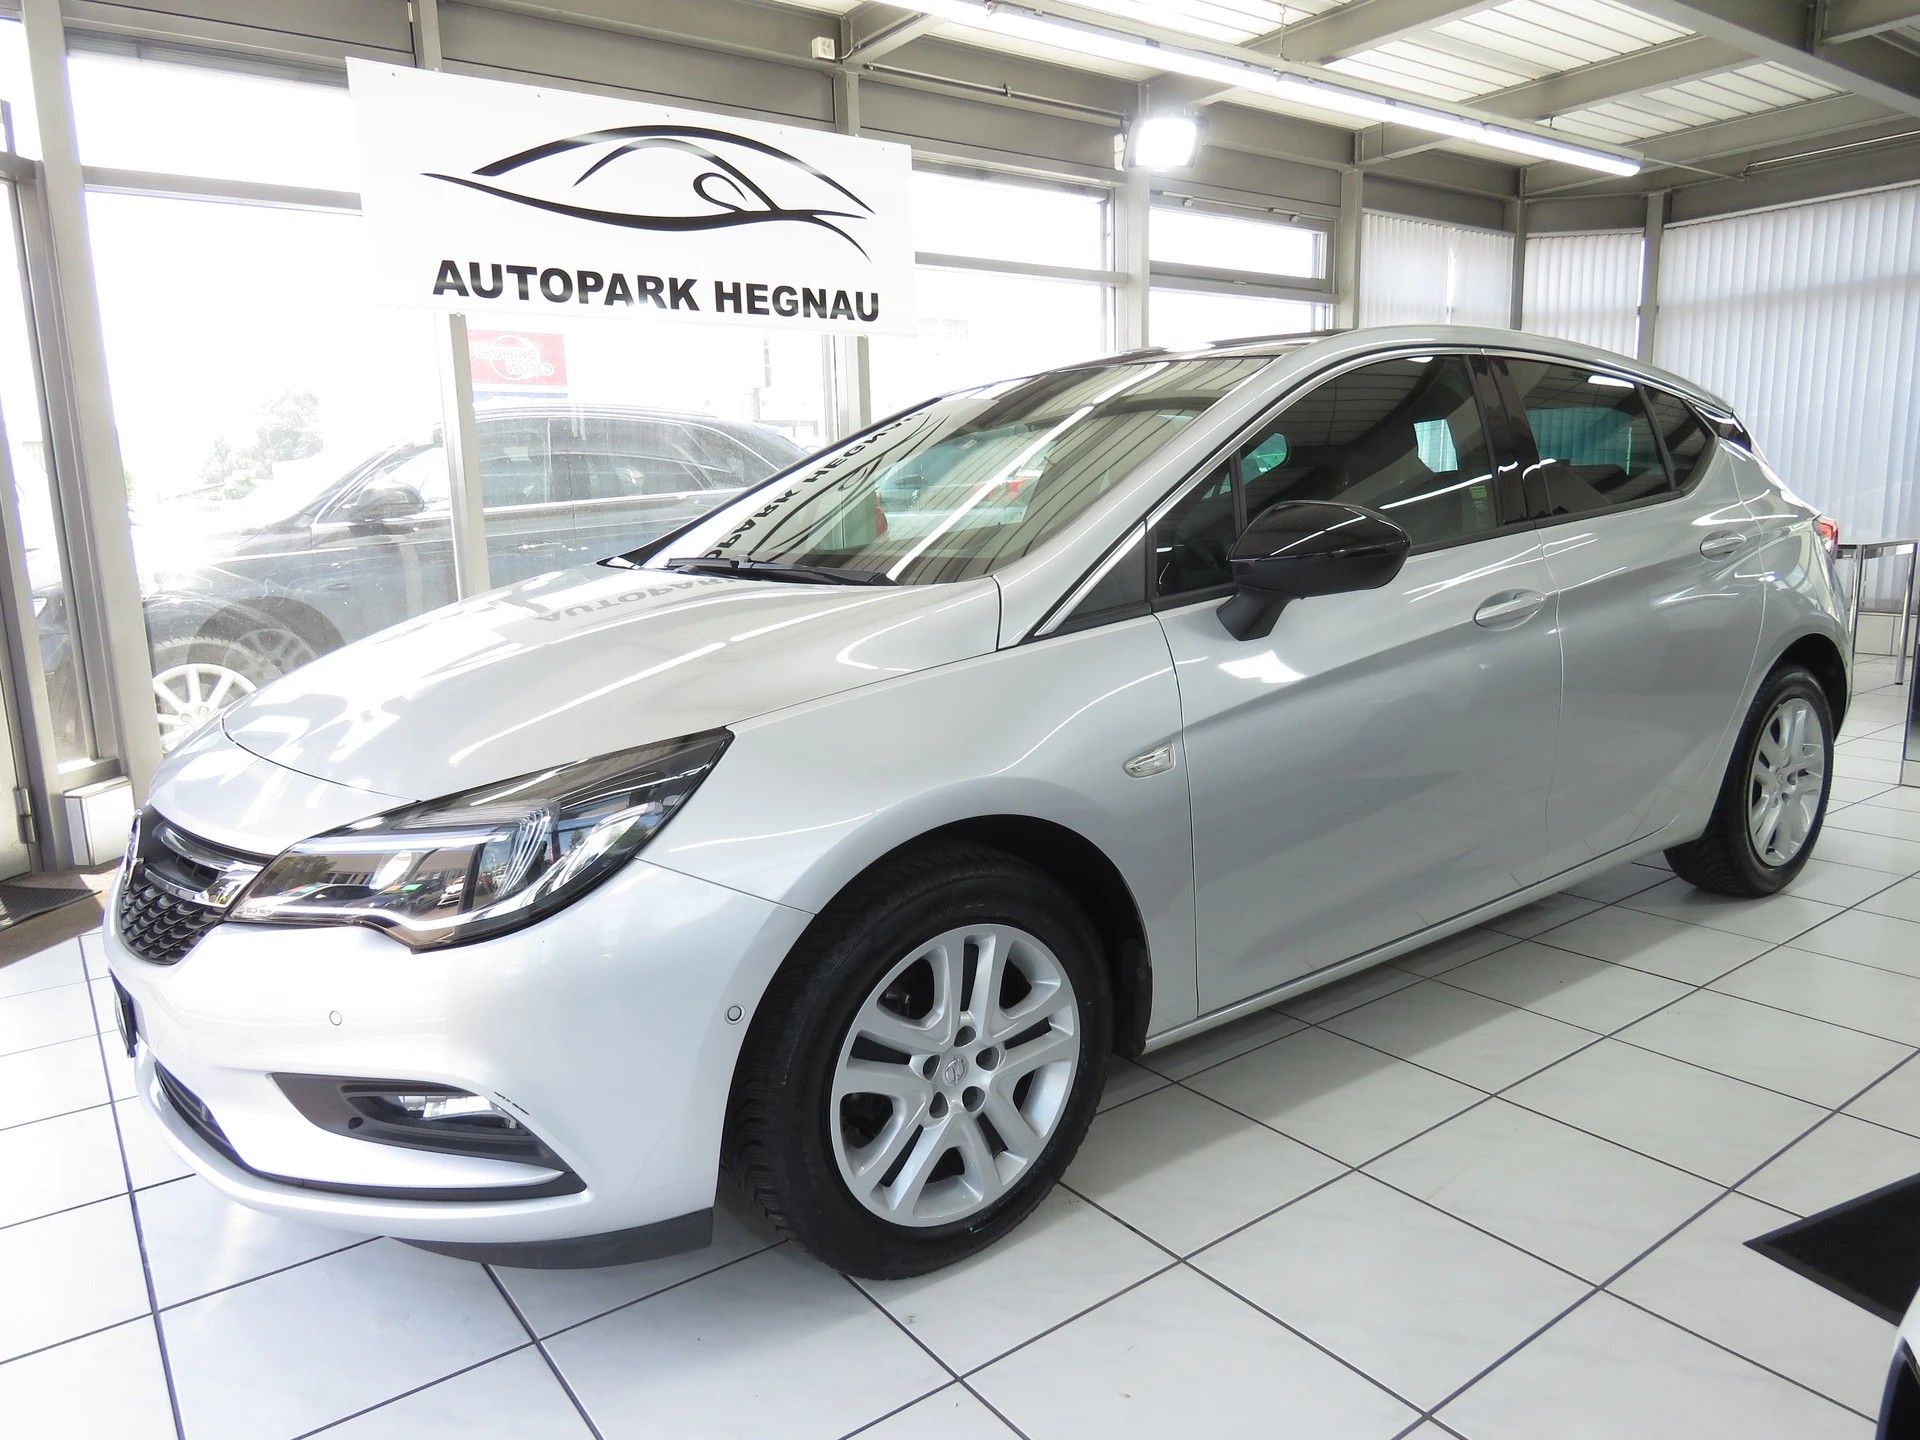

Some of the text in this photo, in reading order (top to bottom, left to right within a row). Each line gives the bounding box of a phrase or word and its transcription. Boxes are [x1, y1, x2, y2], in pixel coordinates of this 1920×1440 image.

[433, 259, 879, 322] AUTOPARK HEGNAU
[507, 361, 553, 375] WORLD
